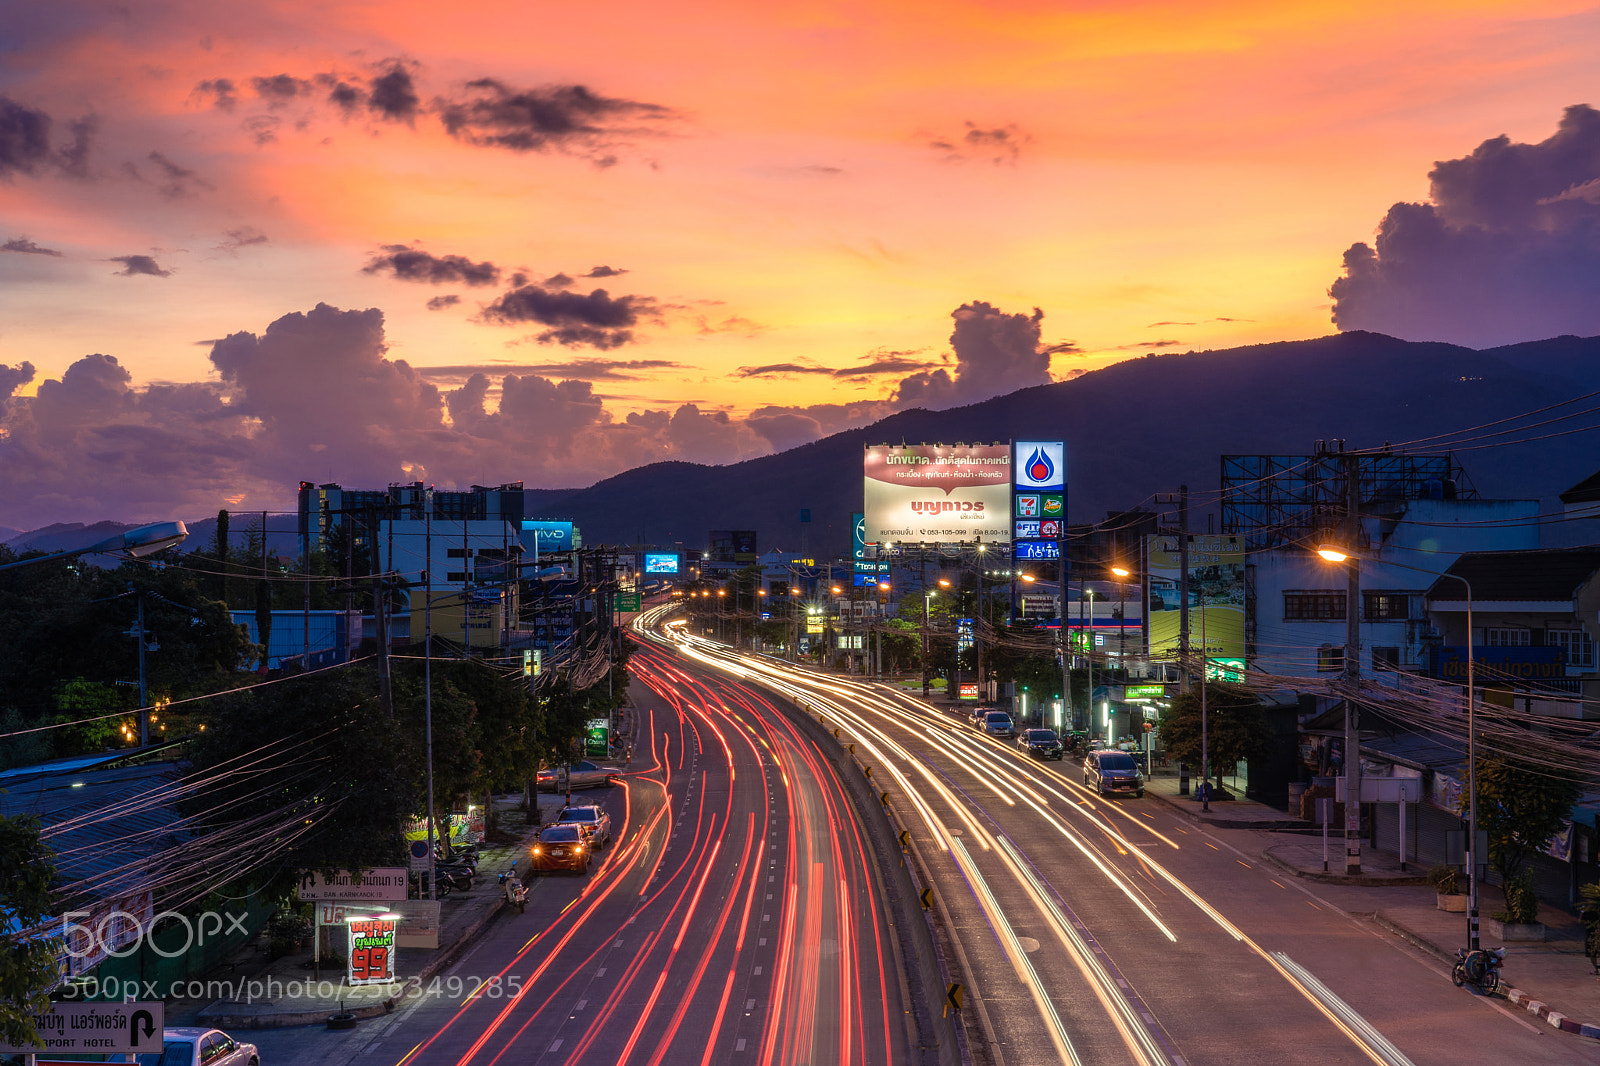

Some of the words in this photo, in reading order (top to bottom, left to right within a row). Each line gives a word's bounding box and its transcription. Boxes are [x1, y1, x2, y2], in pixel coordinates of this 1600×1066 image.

[911, 501, 985, 515] บุญถาวร
[1021, 498, 1035, 515] 7
[394, 876, 405, 887] 19
[31, 1039, 76, 1047] ARPORT
[83, 1039, 116, 1048] HOTEL
